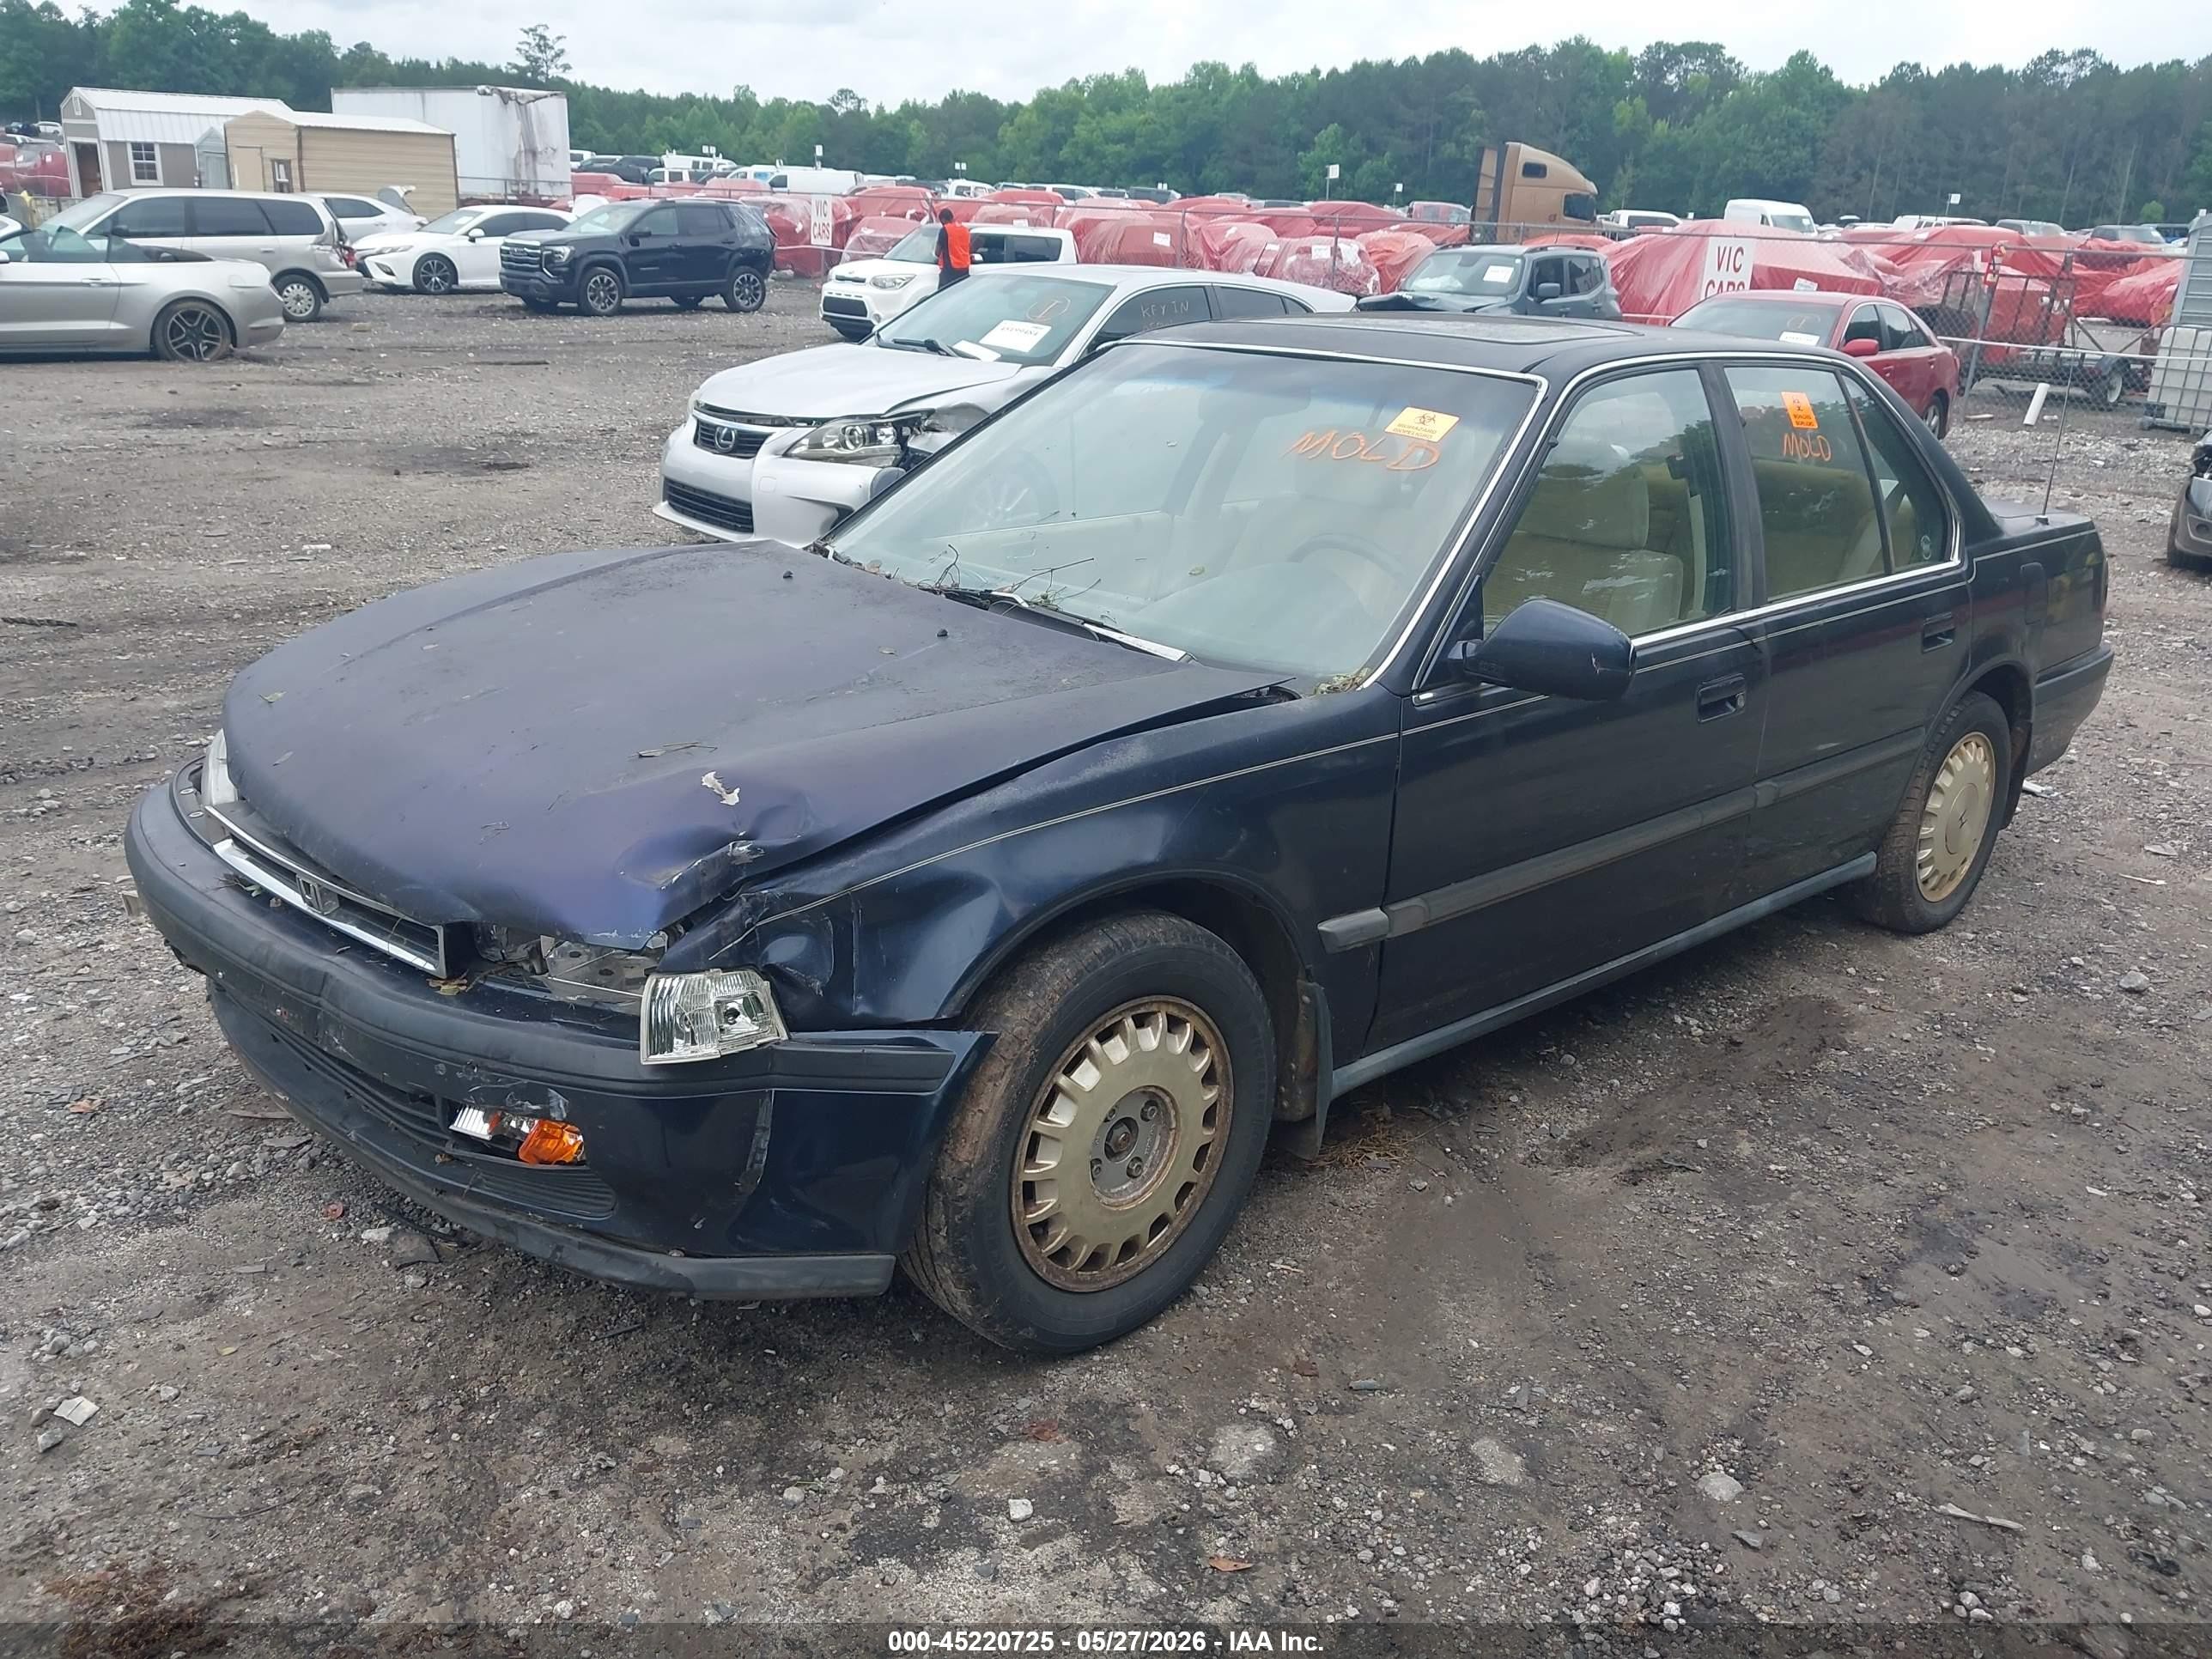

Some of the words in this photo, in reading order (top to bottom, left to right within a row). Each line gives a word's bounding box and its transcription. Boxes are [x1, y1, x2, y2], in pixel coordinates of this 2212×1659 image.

[815, 199, 829, 217] VIC
[812, 222, 830, 240] CARS
[1717, 246, 1744, 273] VIC
[1280, 429, 1442, 471] MOLD
[1783, 431, 1832, 462] MOLD
